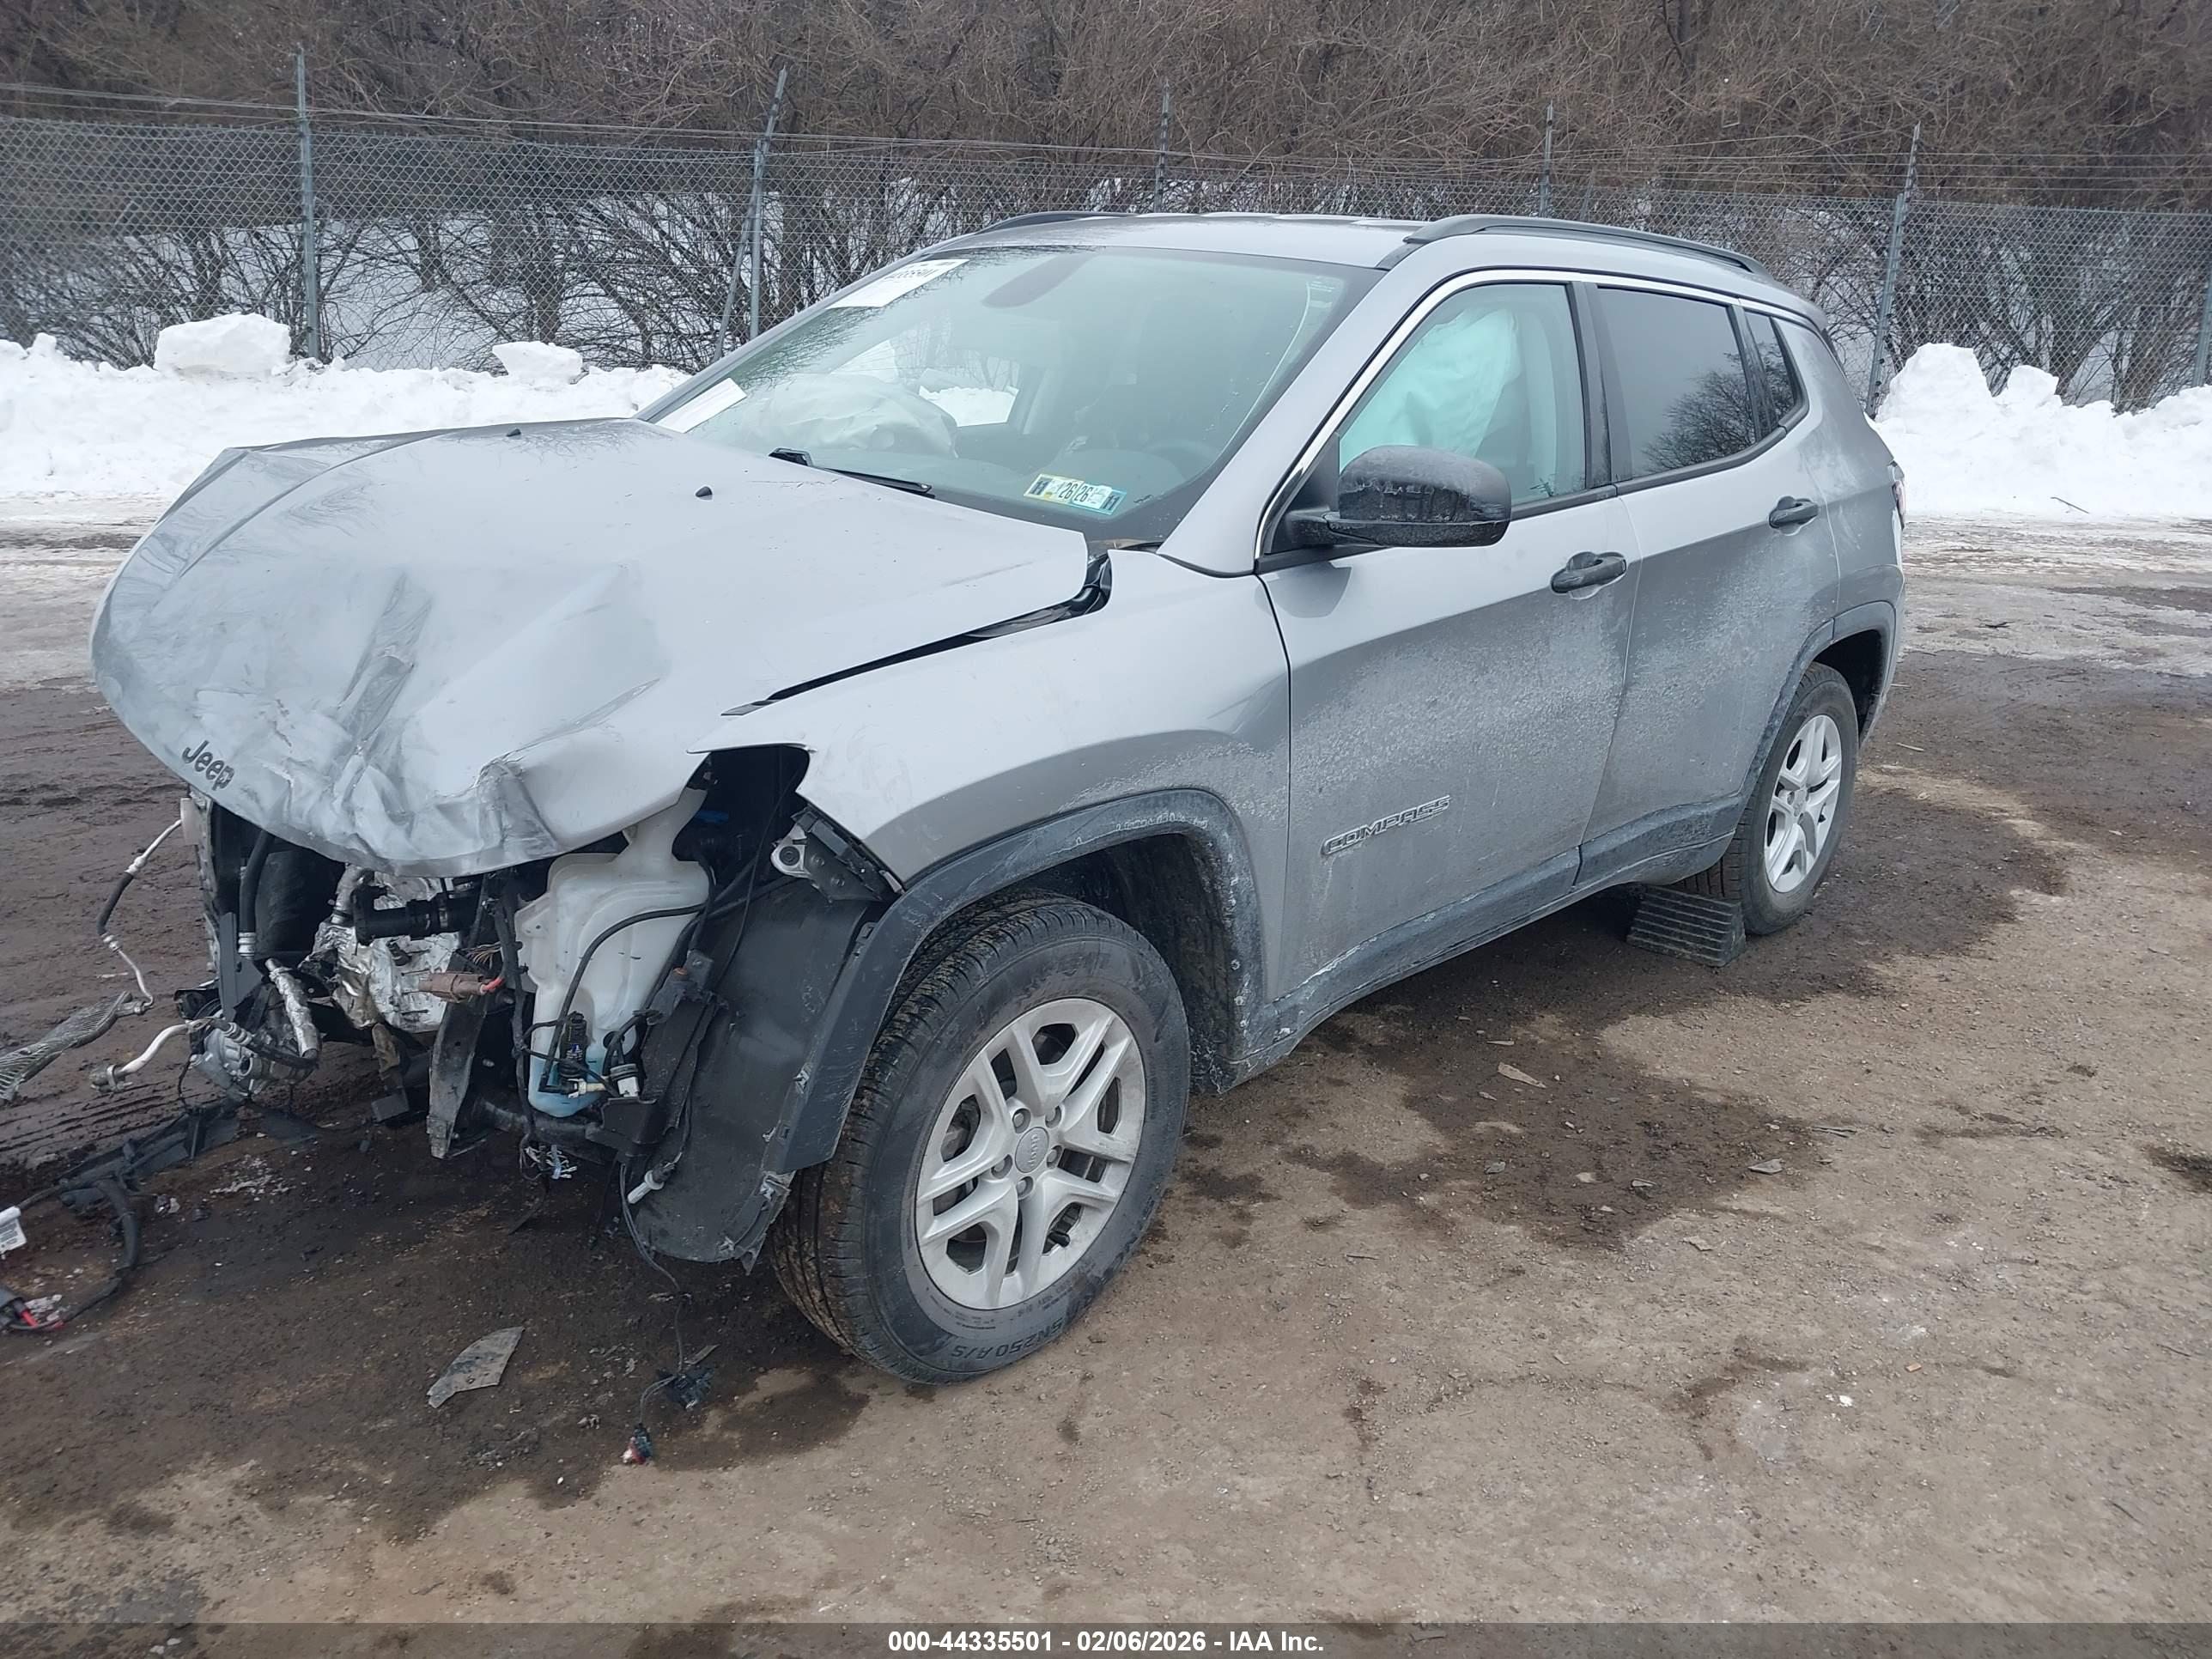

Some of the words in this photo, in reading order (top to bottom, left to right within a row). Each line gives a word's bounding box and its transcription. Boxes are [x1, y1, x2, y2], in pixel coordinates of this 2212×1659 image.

[1059, 482, 1078, 500] 26
[1074, 485, 1093, 502] 26
[182, 740, 234, 791] Jeep
[1320, 794, 1450, 856] COMPASS
